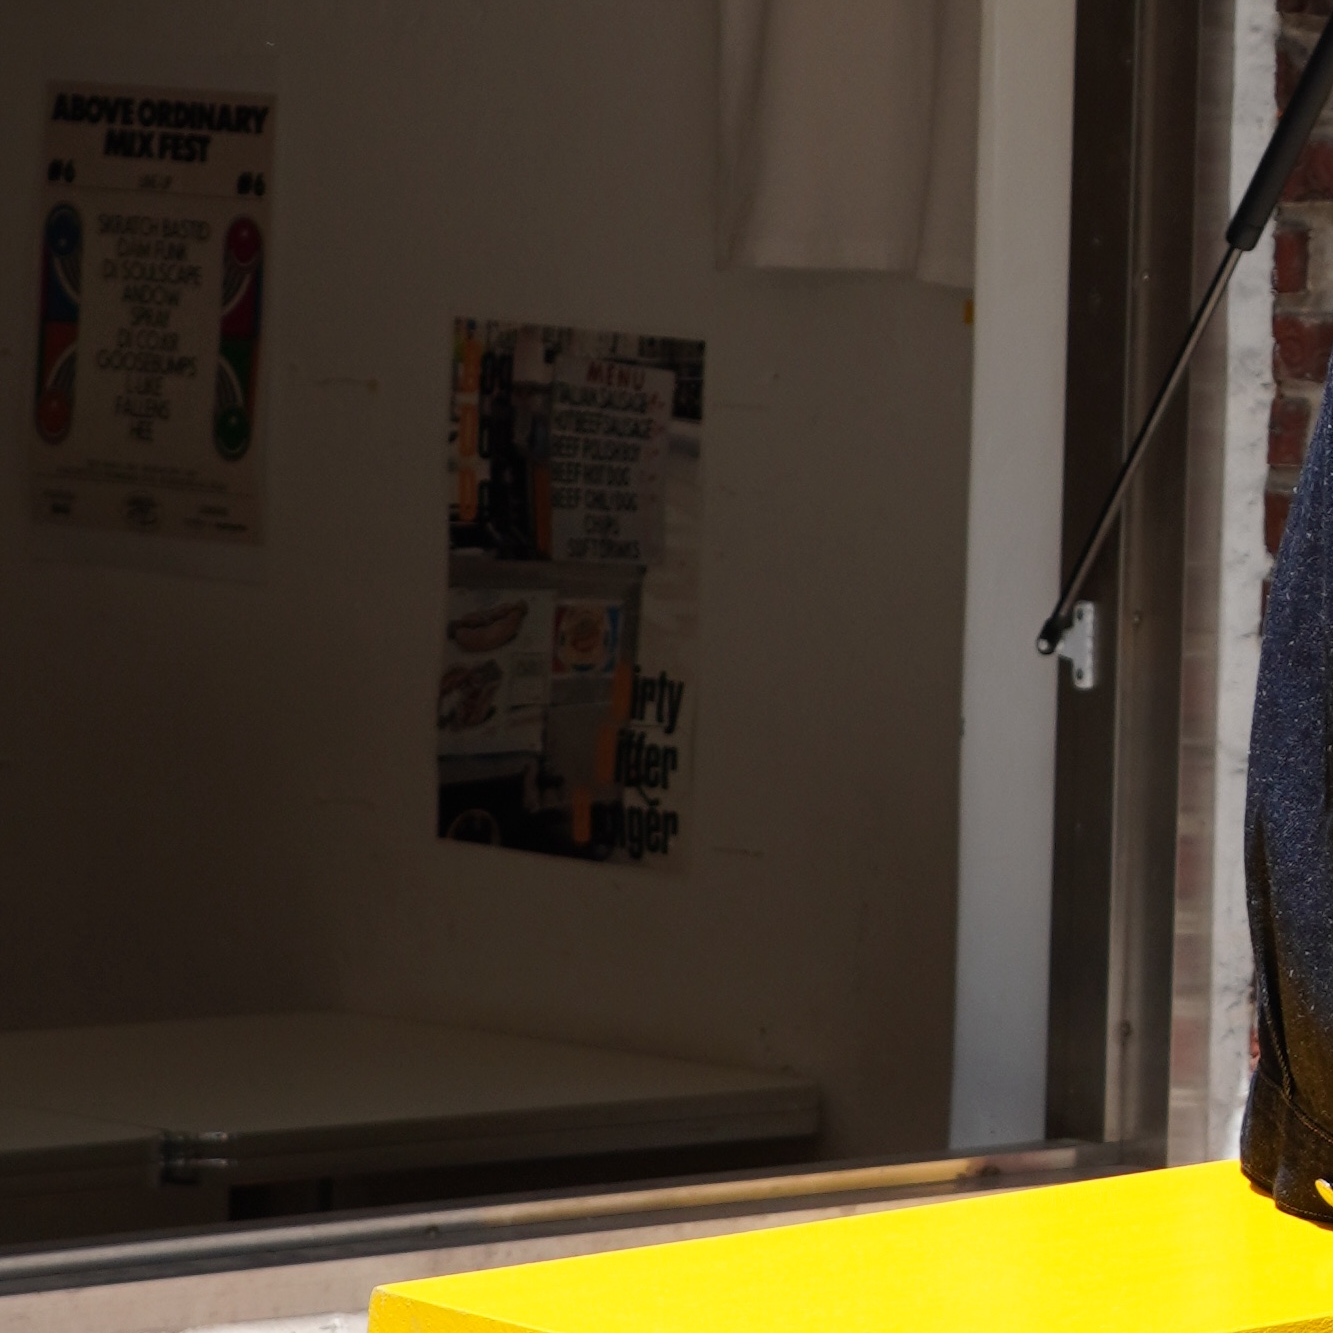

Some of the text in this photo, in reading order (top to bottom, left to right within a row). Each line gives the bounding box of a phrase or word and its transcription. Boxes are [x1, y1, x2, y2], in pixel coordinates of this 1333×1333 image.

[52, 92, 269, 134] ABOVE ORDINARY
[103, 129, 211, 163] MIX FEST
[47, 158, 76, 184] #6
[236, 170, 267, 197] #6
[586, 361, 647, 391] MENU
